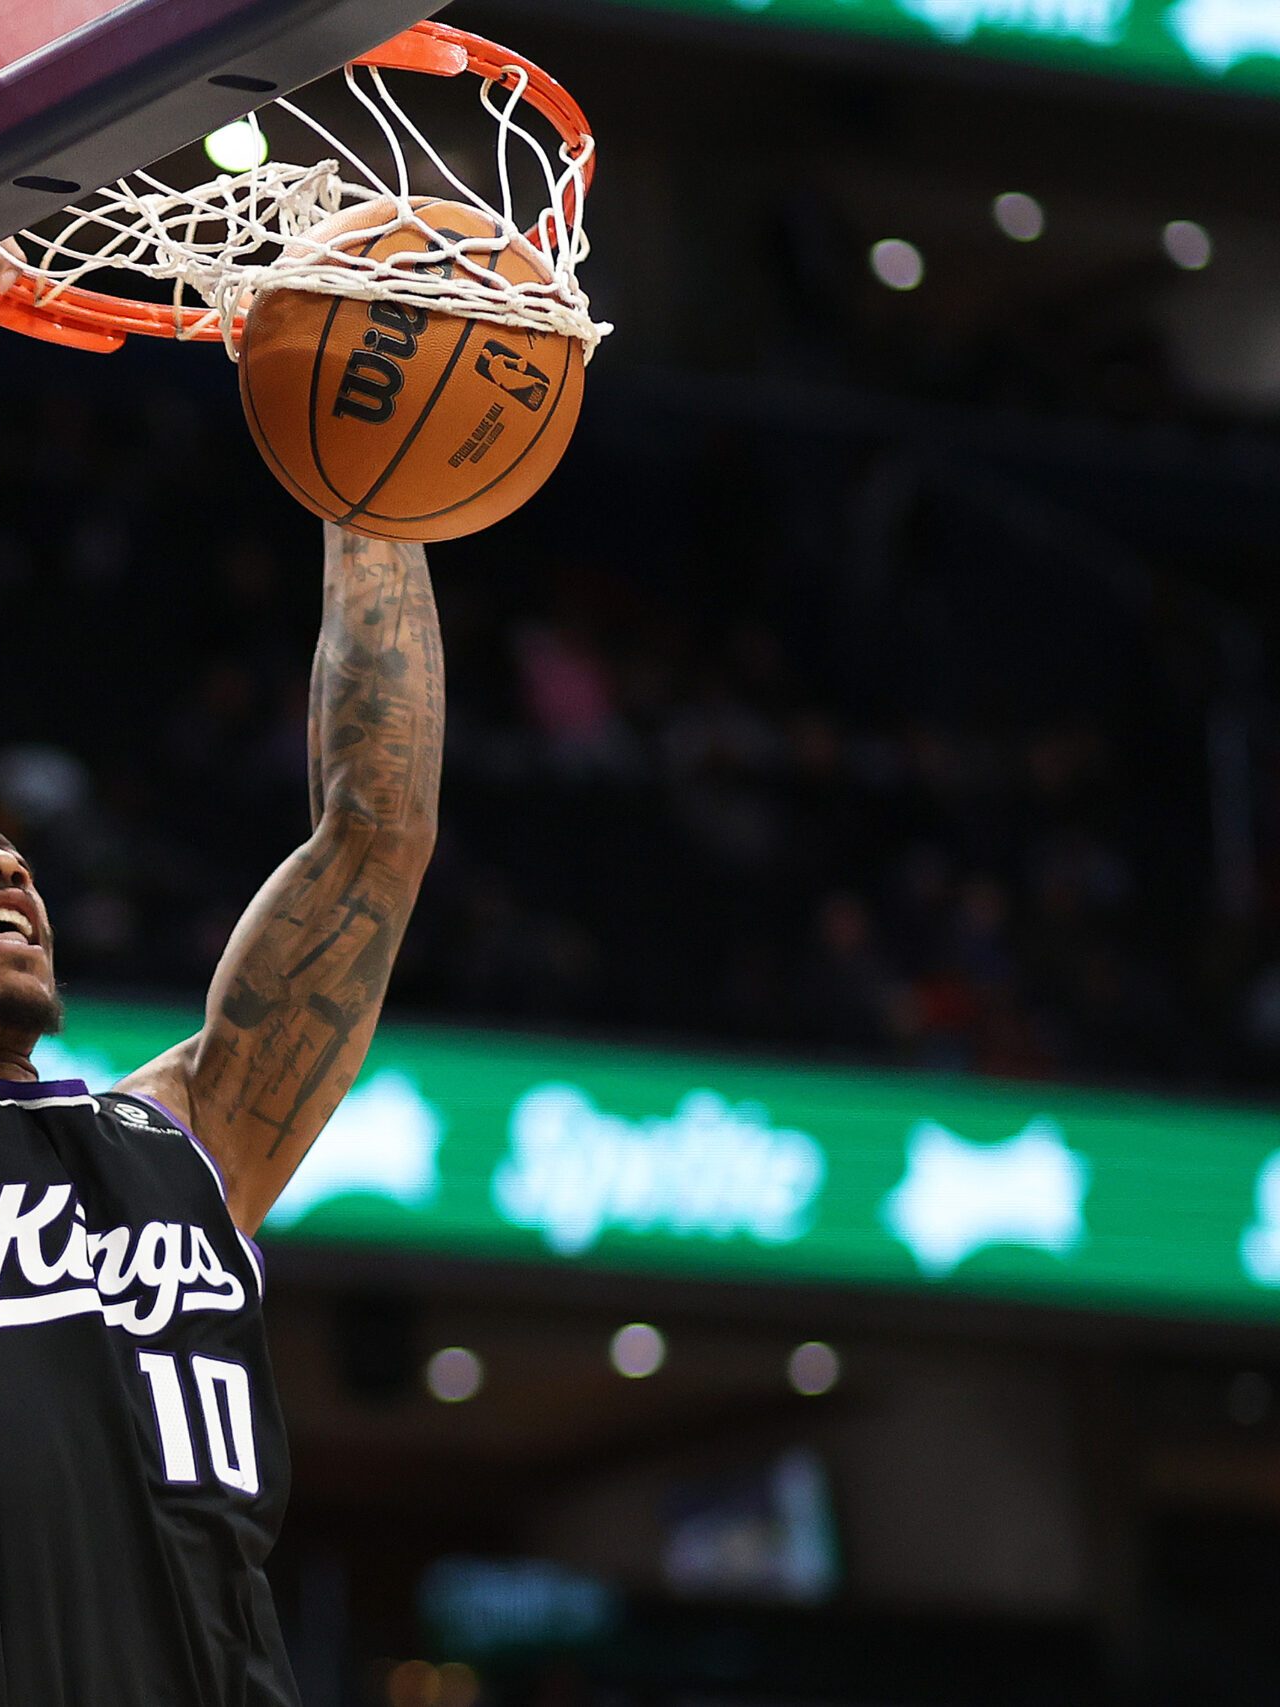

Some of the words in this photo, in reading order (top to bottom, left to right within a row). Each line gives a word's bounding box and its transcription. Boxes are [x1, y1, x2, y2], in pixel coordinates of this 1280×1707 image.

[471, 418, 493, 442] GAME
[485, 401, 504, 422] BALL
[136, 1348, 261, 1497] 10
